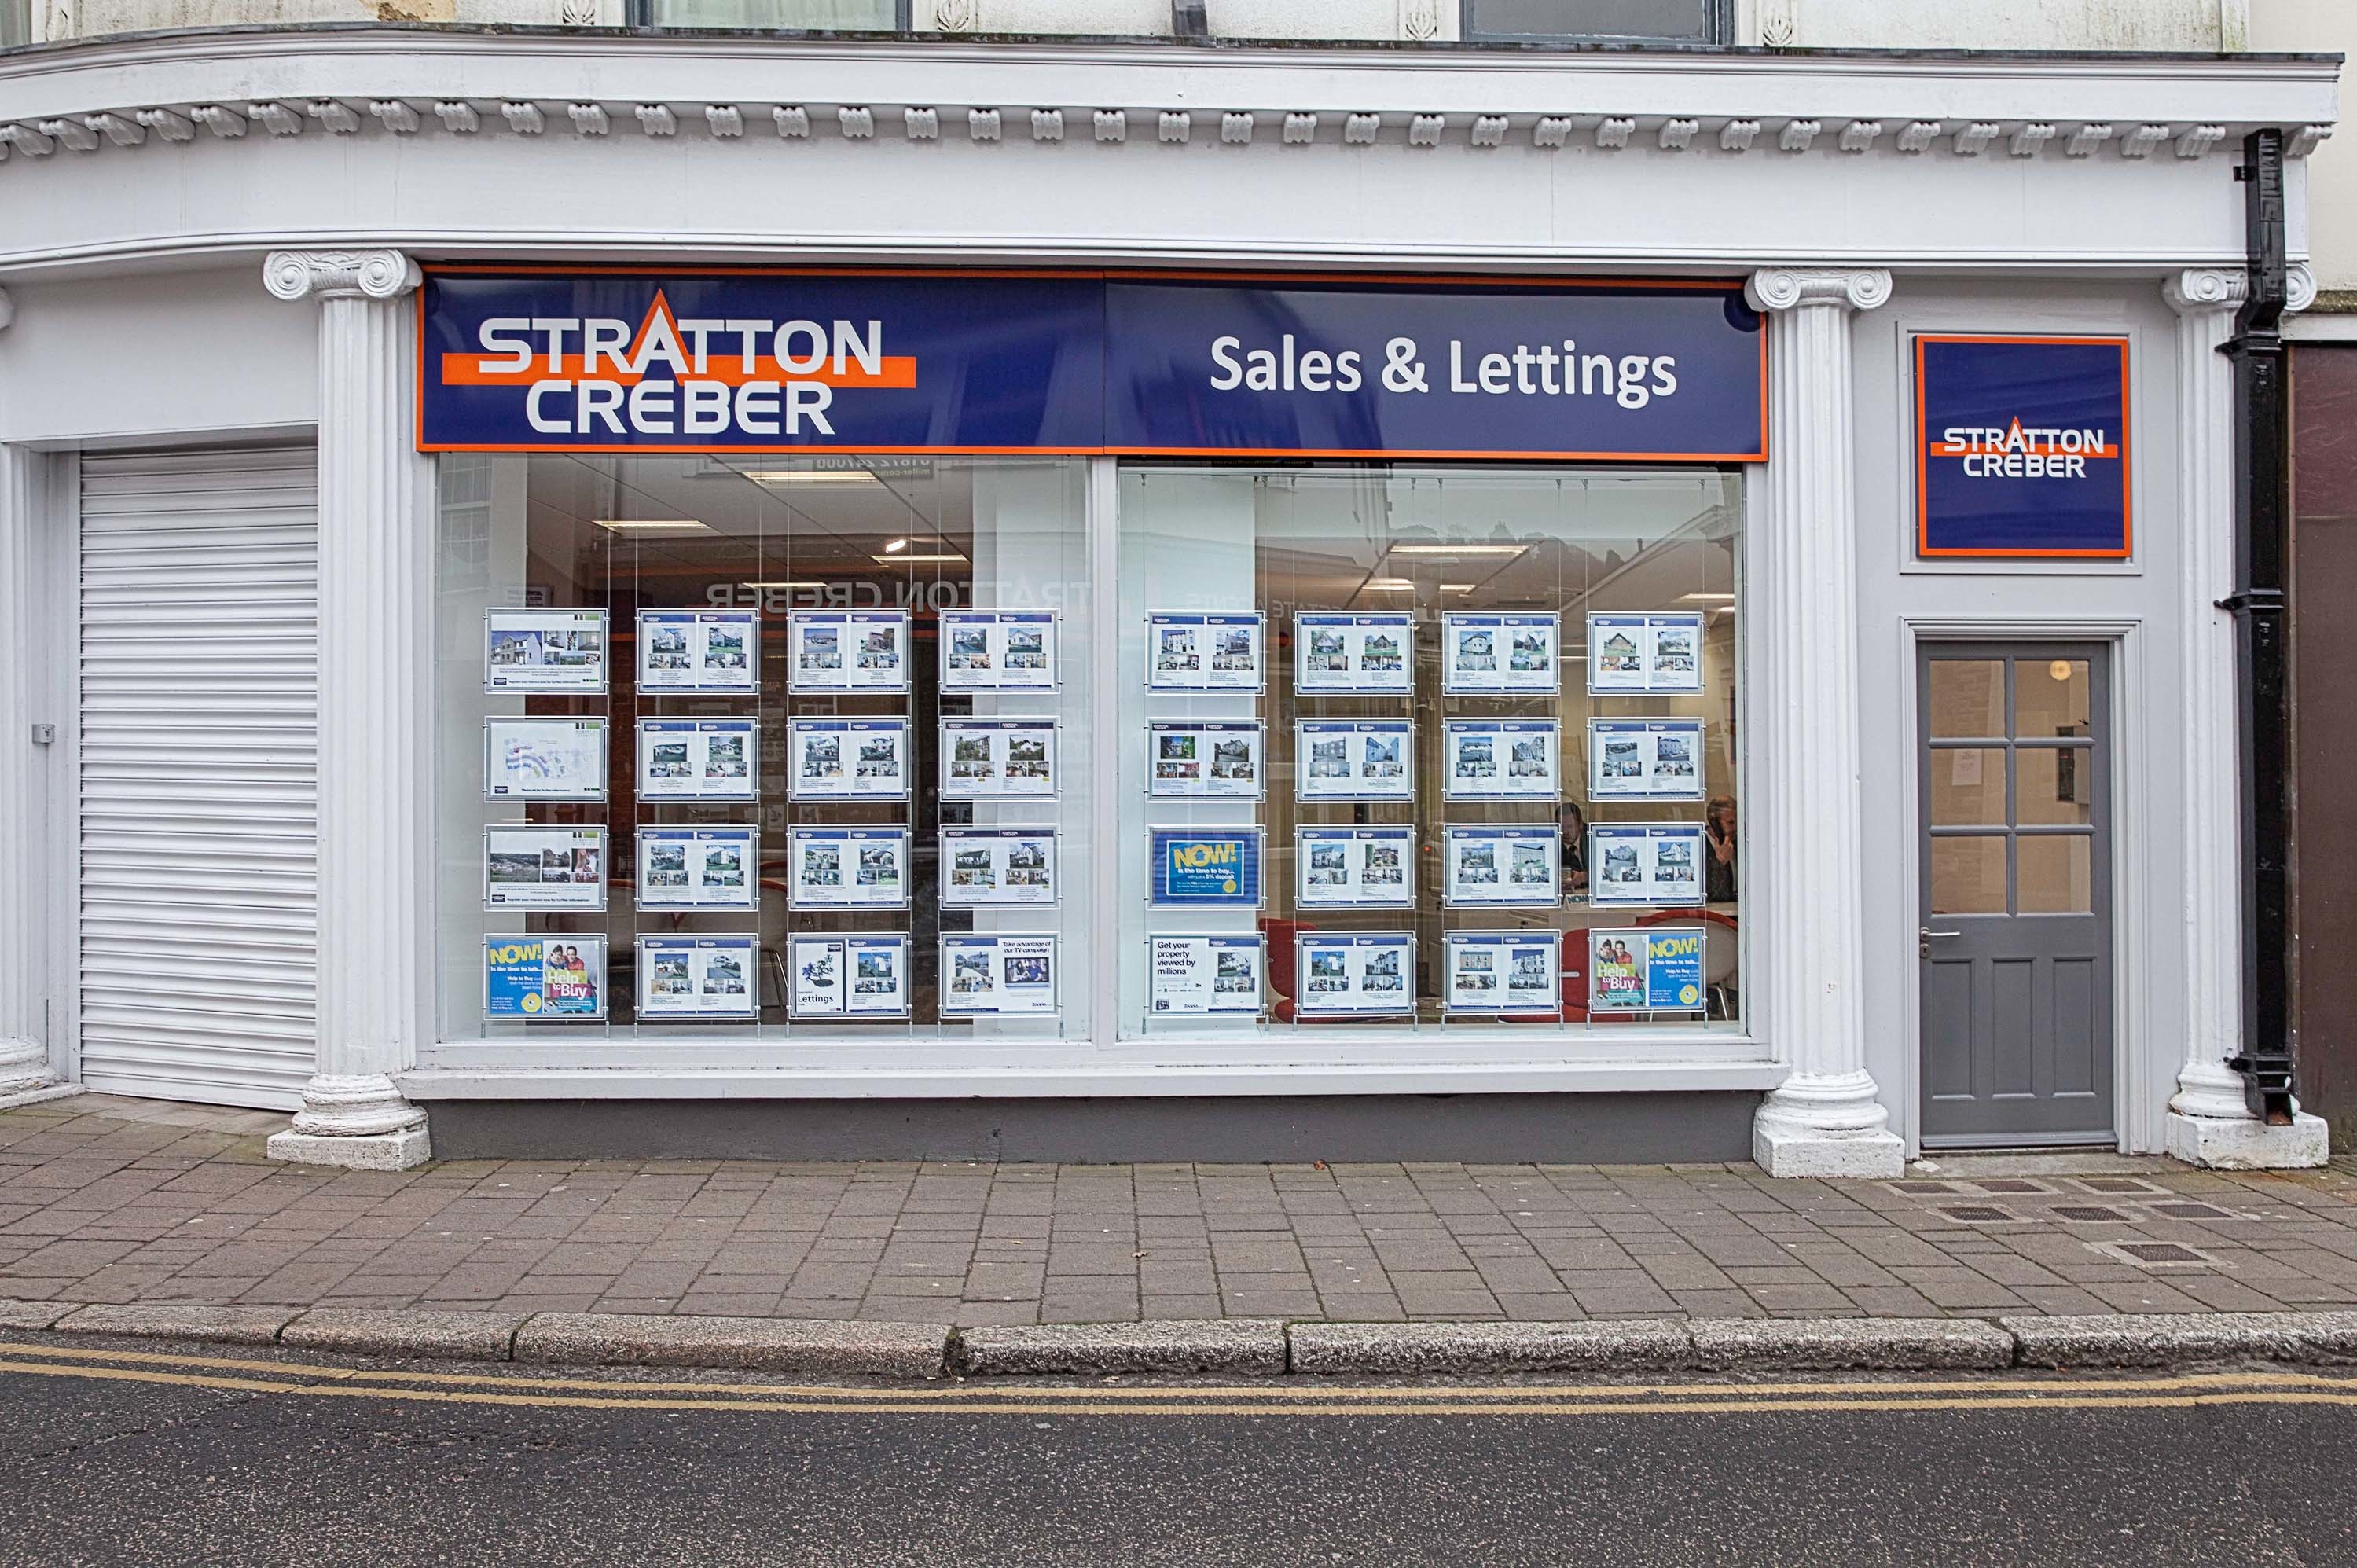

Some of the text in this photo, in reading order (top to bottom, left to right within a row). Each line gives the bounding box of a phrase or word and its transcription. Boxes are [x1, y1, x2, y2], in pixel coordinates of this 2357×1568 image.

[478, 305, 882, 376] STRATTON
[1210, 334, 1677, 409] Sales & Lettings
[526, 380, 836, 435] CREBER
[1944, 423, 2105, 454] STRATTON
[1963, 454, 2087, 479] CREBER
[1173, 843, 1236, 868] NOW!
[490, 943, 543, 965] NOW!
[1649, 937, 1698, 958] NOW!
[1186, 959, 1195, 968] by
[1598, 964, 1627, 980] Help
[547, 970, 579, 986] Help
[1610, 978, 1635, 992] Buy
[560, 984, 587, 1000] Buy
[798, 995, 834, 1004] Lettings
